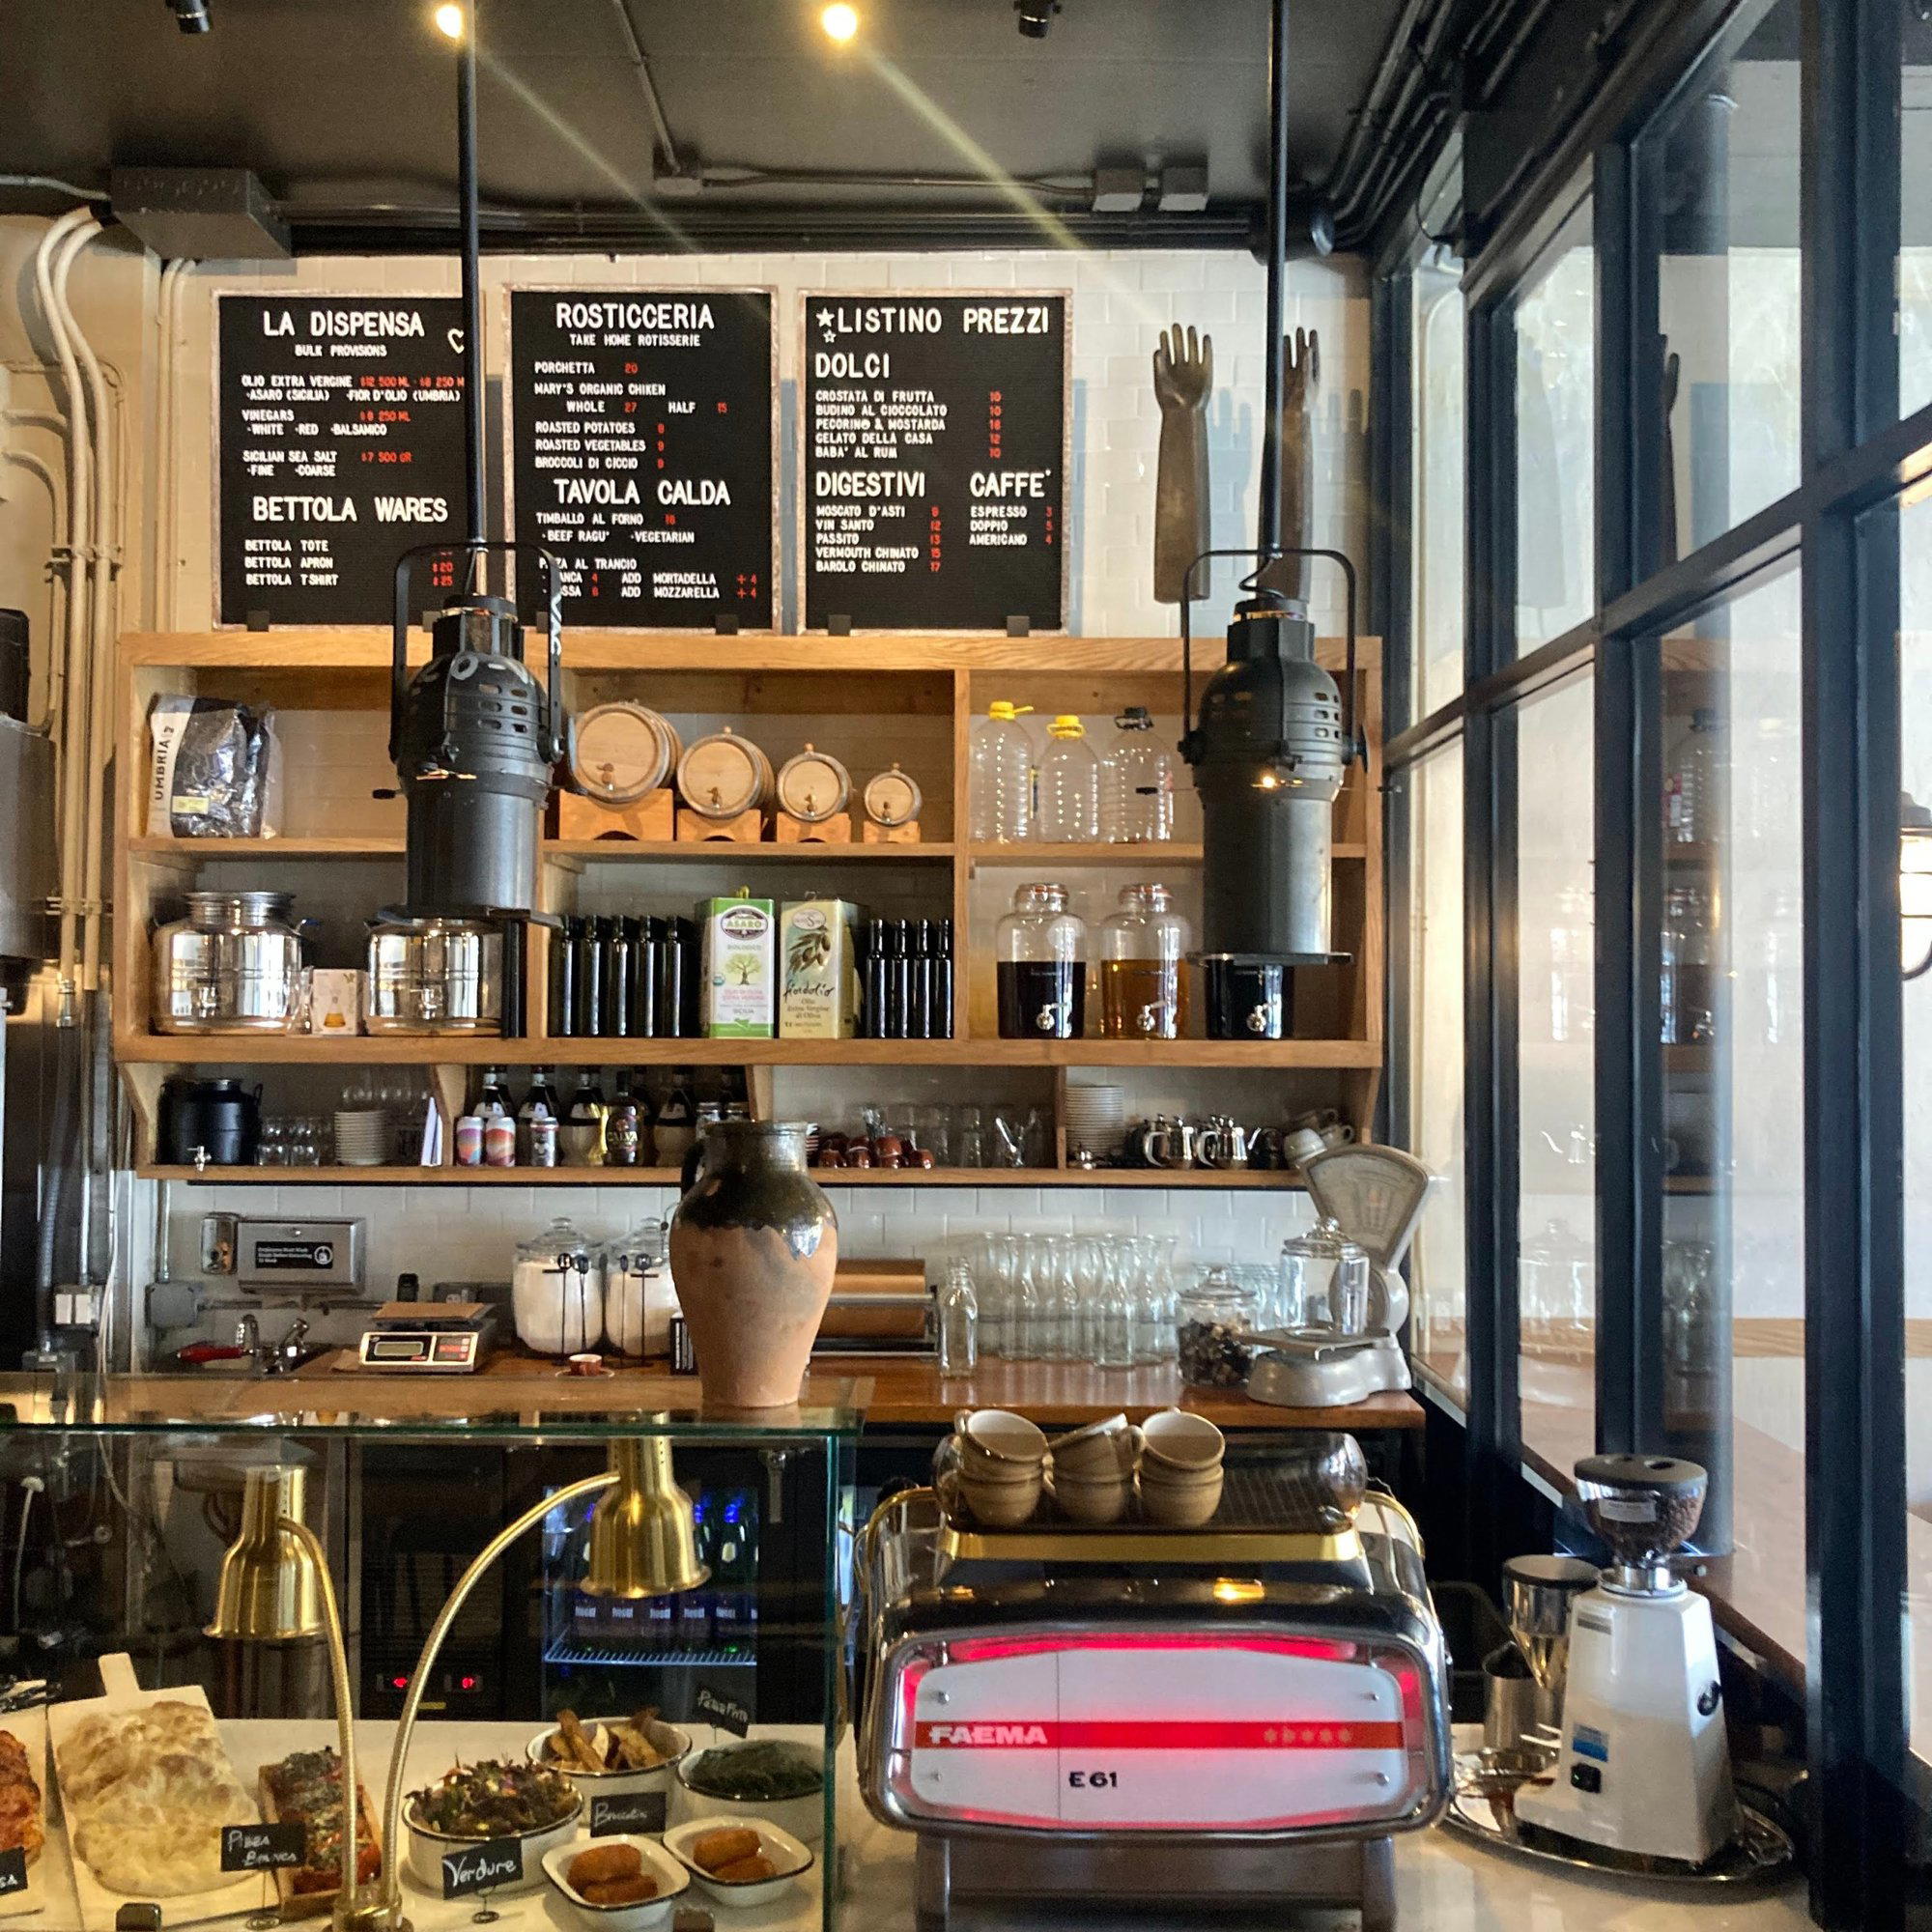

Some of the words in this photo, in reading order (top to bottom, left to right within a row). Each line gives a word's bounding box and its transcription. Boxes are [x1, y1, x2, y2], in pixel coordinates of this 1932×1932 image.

[556, 302, 714, 328] ROSTICCERIA
[838, 307, 942, 332] LISTINO
[963, 306, 1048, 333] PREZZI
[264, 311, 295, 335] LA
[311, 310, 424, 336] DISPENSA
[570, 334, 595, 345] TAKE
[604, 334, 631, 346] HOME
[639, 334, 700, 346] ROTISSERIE
[295, 345, 322, 356] BULK
[330, 344, 386, 356] PROVISIONS
[535, 361, 595, 374] PORCHETTA
[626, 363, 638, 373] 20
[815, 353, 889, 378] DOLCI
[242, 375, 265, 389] OLIO
[271, 375, 305, 389] EXTRA
[310, 376, 353, 387] VERGINE
[412, 389, 460, 401] (UMBRIA)
[534, 383, 574, 394] MARY'S
[580, 383, 623, 395] ORGANIC
[629, 384, 666, 395] CHIKEN
[815, 390, 867, 402] CROSTATA
[873, 390, 884, 402] DI
[893, 390, 934, 402] FRUTTA
[567, 401, 605, 412] WHOLE
[625, 403, 636, 412] 27
[668, 402, 696, 412] HALF
[816, 404, 855, 415] BUDINO
[862, 405, 875, 416] AL
[880, 404, 947, 416] CIOCCOLATO
[242, 410, 294, 421] VINEGARS
[535, 421, 580, 433] ROASTED
[584, 421, 635, 434] POTATOES
[816, 418, 872, 433] PECORINO
[888, 418, 945, 433] MOSTARDA
[815, 432, 856, 443] GELATO
[862, 432, 896, 444] DELLA
[905, 432, 932, 444] CASA
[535, 439, 581, 450] ROASTED
[584, 440, 645, 451] VEGETABLES
[242, 450, 284, 462] SICILIAN
[289, 450, 308, 462] SEA
[314, 451, 337, 463] SALT
[855, 446, 868, 458] AL
[873, 446, 897, 458] RUM
[535, 456, 582, 469] BROCCOLI
[588, 457, 599, 469] DI
[606, 457, 638, 469] CICCIO
[816, 470, 924, 497] DIGESTIVI
[554, 479, 639, 504] TAVOLA
[658, 480, 730, 505] CALDA
[253, 497, 356, 522] BETTOLA
[374, 497, 447, 522] WARES
[816, 505, 861, 520] MOSCATO
[868, 505, 905, 520] D'ASTI
[971, 505, 1027, 521] ESPRESSO
[536, 512, 584, 524] TIMBALLO
[592, 513, 606, 525] AL
[611, 513, 643, 525] FORNO
[815, 520, 835, 530] VIN
[840, 519, 874, 530] SANTO
[970, 520, 1008, 534] DOPPIO
[816, 532, 862, 548] PASSITO
[969, 533, 1027, 545] AMERICANO
[245, 540, 292, 552] BETTOLA
[300, 540, 328, 552] TOTE
[815, 547, 871, 561] VERMOUTH
[875, 547, 919, 561] CHINATO
[244, 556, 291, 568] BETTOLA
[300, 556, 333, 569] APRON
[575, 558, 588, 569] AL
[595, 558, 637, 570] TRANCIO
[816, 560, 856, 572] BAROLO
[862, 560, 905, 572] CHINATO
[246, 574, 292, 585] BETTOLA
[622, 573, 641, 583] ADD
[653, 573, 716, 584] MORTADELLA
[621, 586, 640, 597] ADD
[654, 586, 720, 598] MOZZARELLA
[155, 739, 171, 801] UMBRIA
[929, 1725, 1048, 1745] FAEMA
[442, 1856, 517, 1888] Verdure
